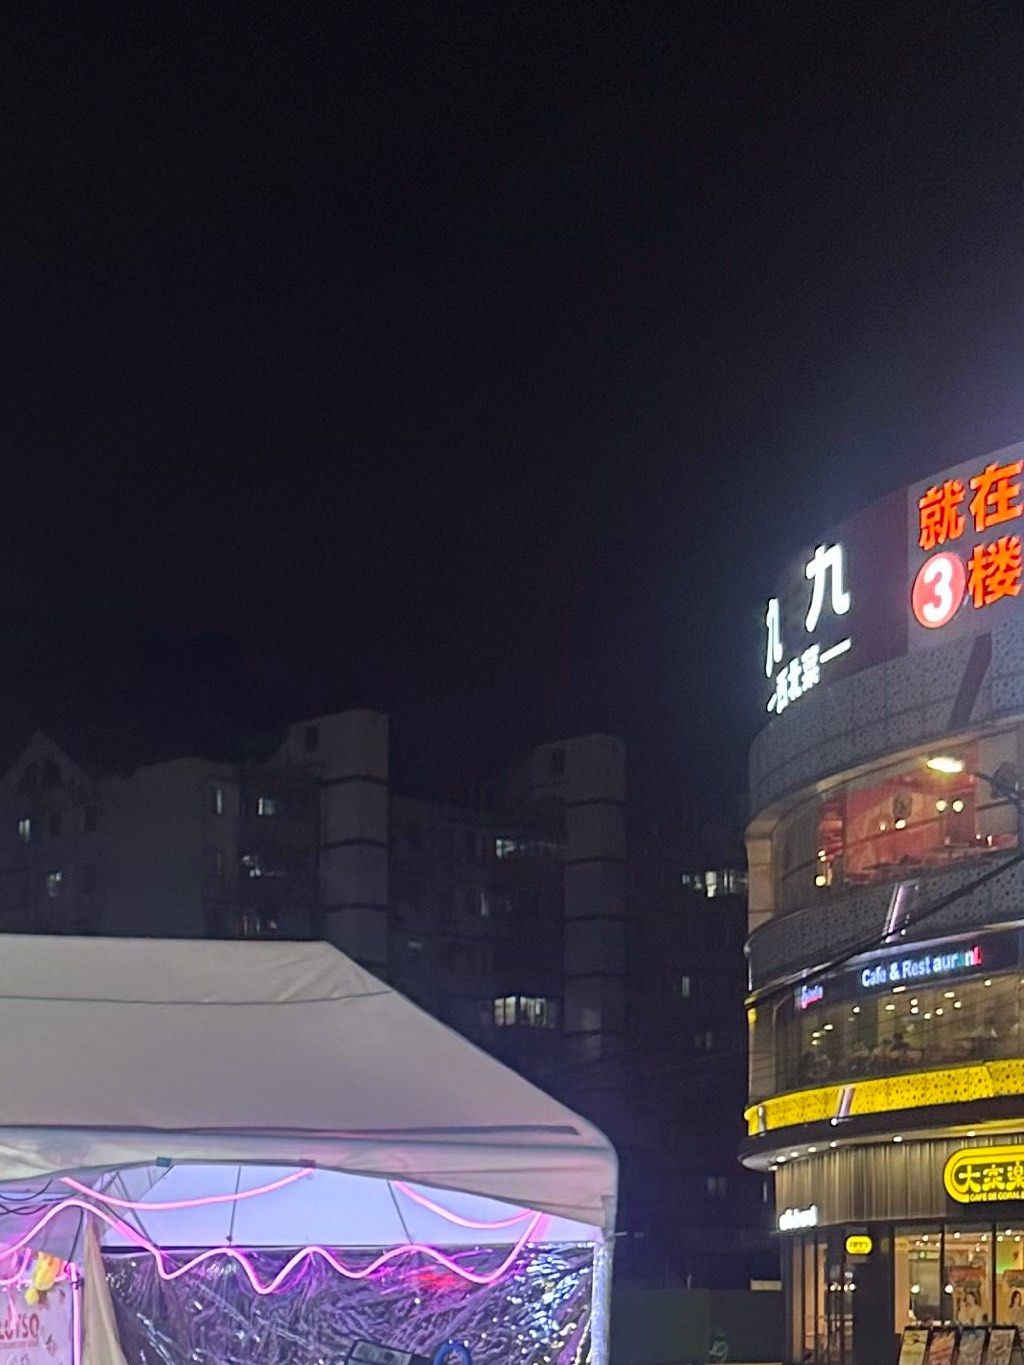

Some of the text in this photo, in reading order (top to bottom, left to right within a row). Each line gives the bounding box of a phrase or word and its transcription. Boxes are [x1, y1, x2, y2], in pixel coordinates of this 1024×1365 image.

[918, 460, 1024, 550] 就在
[861, 965, 887, 988] Cafe
[889, 961, 901, 982] &
